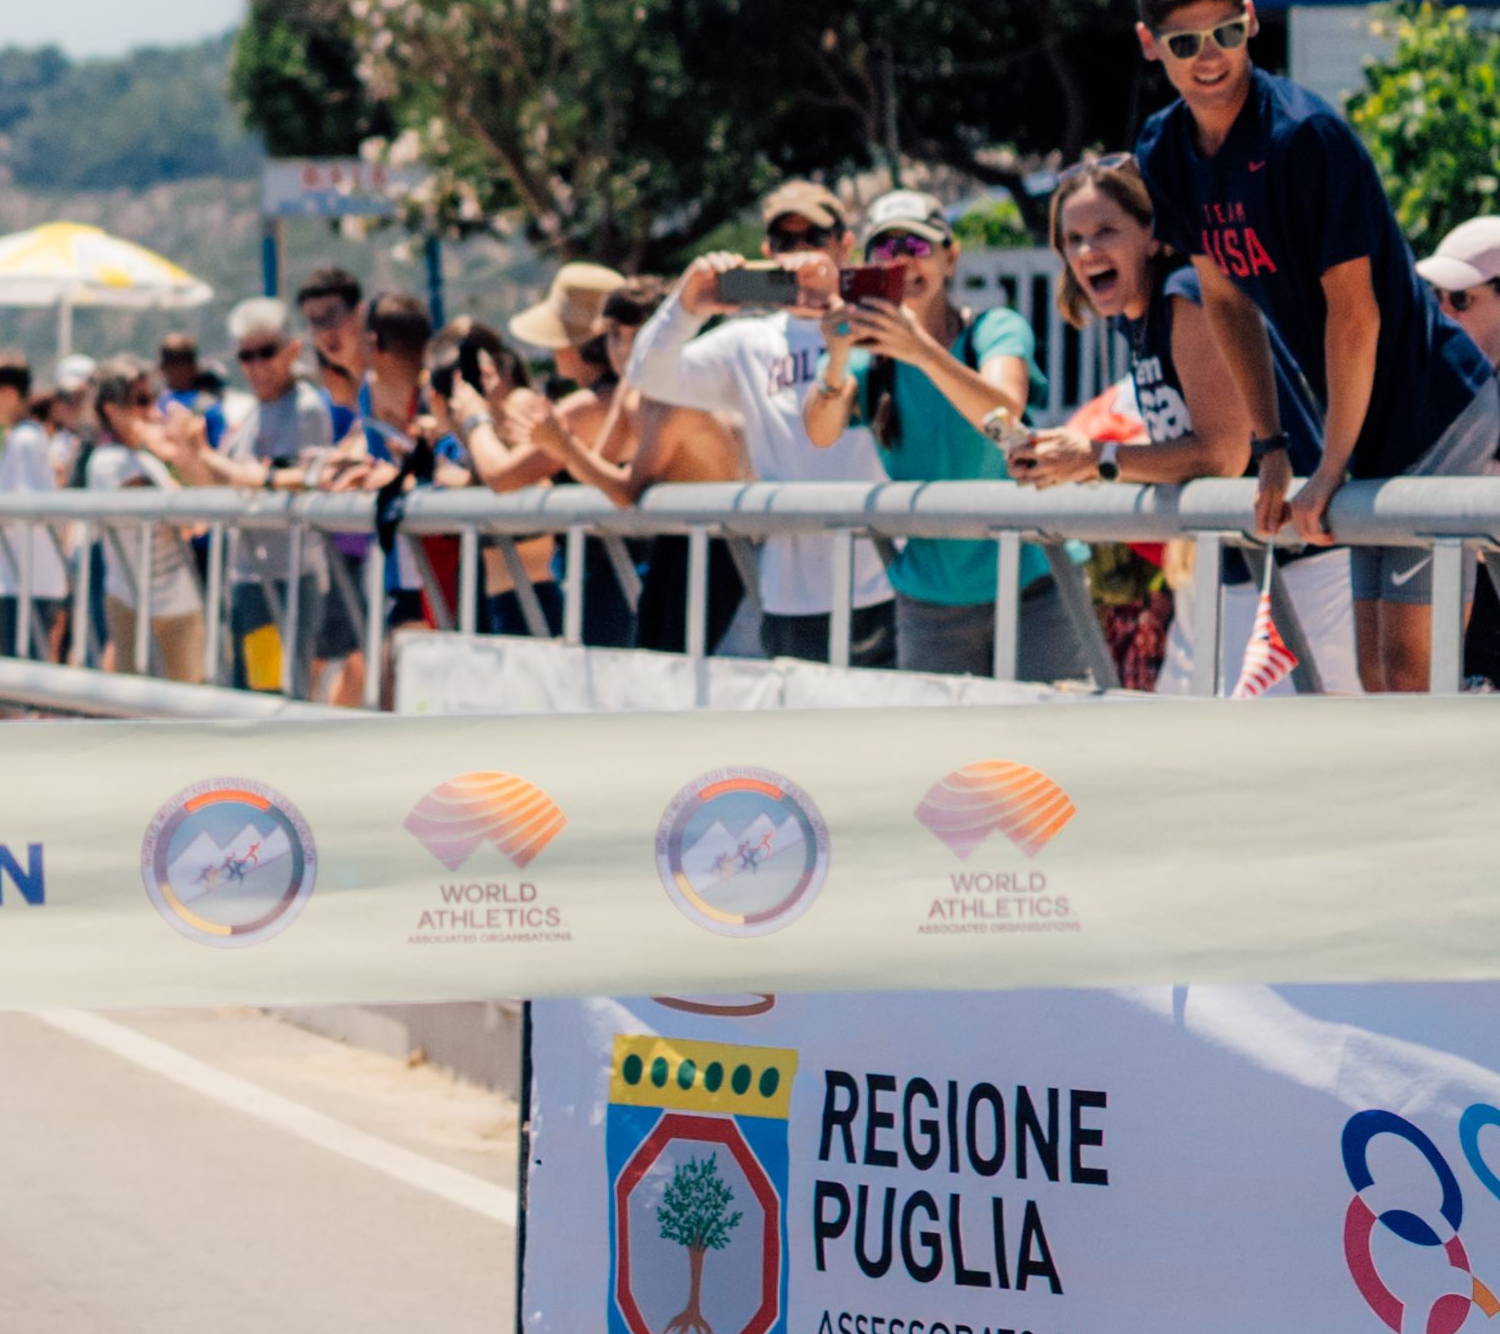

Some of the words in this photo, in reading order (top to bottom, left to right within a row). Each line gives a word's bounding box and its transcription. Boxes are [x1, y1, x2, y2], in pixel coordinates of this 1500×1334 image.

[1202, 202, 1245, 224] TEAM
[1202, 227, 1277, 278] USA
[440, 882, 538, 904] WORLD
[950, 872, 1047, 894] WORLD
[417, 906, 562, 930] ATHLETICS
[927, 896, 1071, 920] ATHLETICS
[818, 1069, 1110, 1187] REGIONE
[813, 1180, 1064, 1295] PUGLIA
